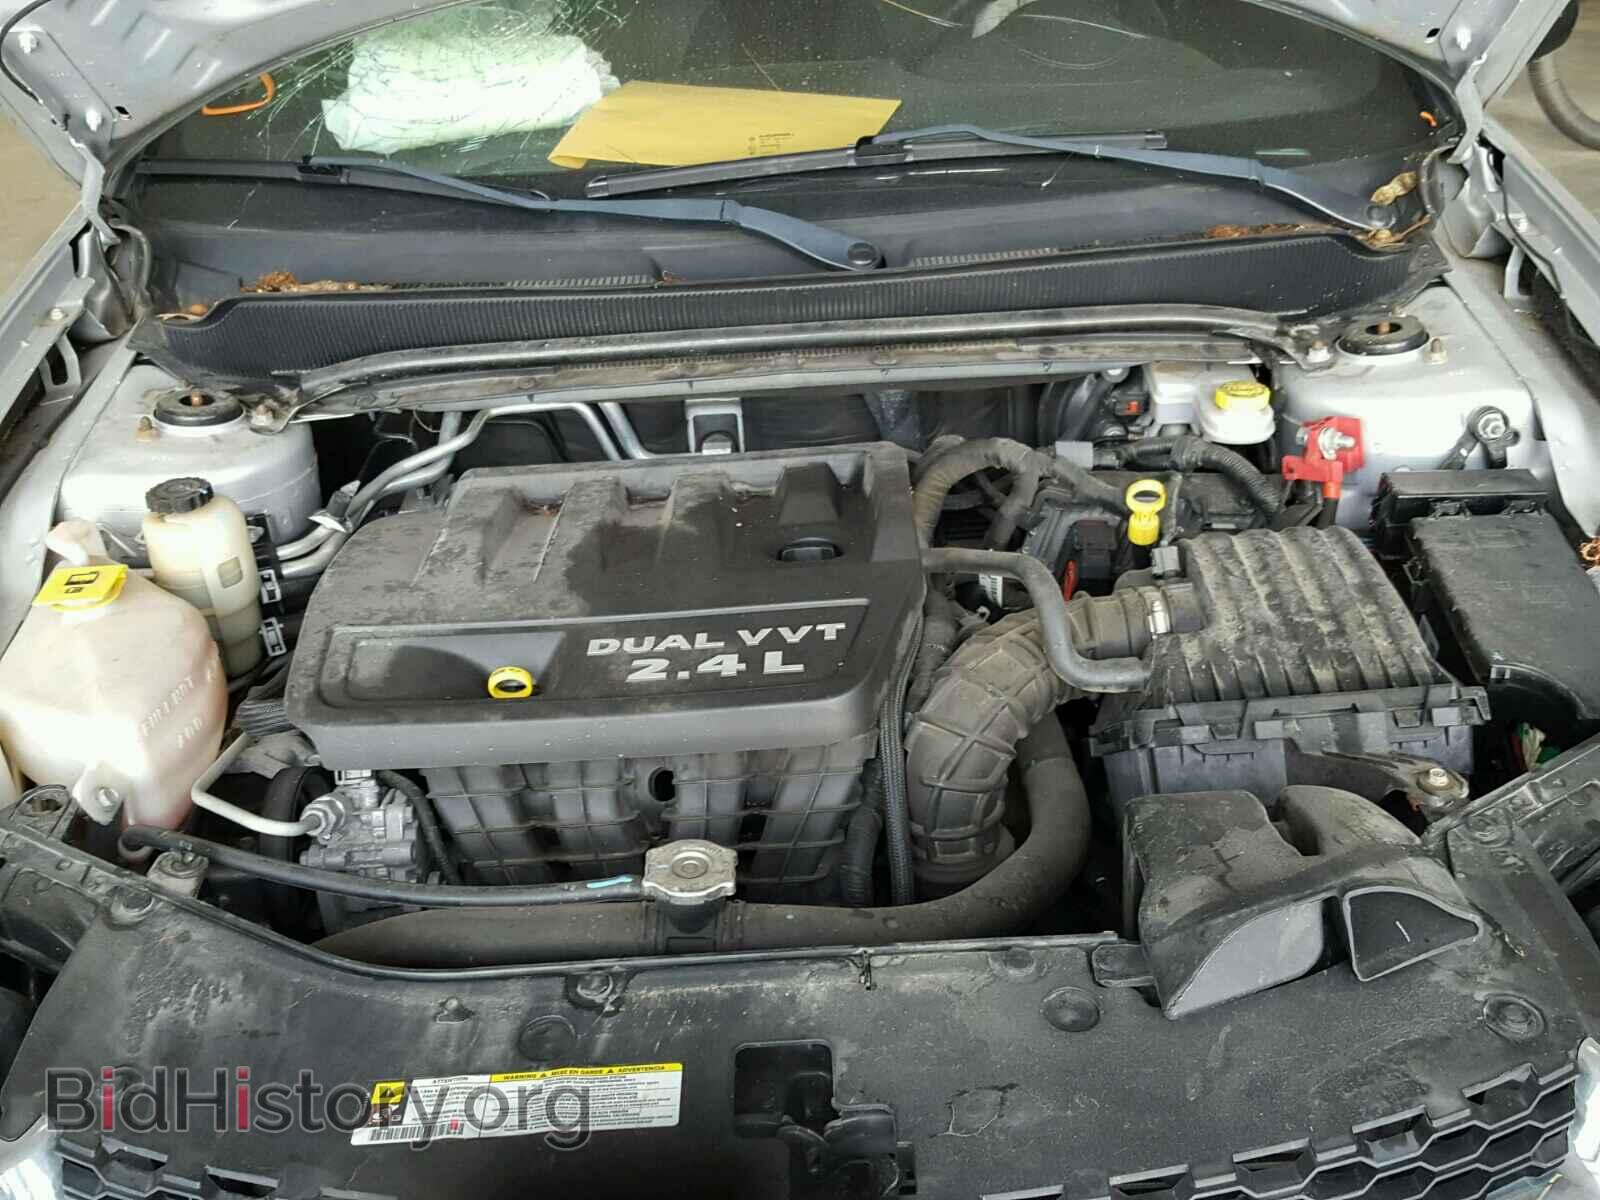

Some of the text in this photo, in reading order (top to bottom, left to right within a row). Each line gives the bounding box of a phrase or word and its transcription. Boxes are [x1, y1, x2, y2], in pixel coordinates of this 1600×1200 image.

[587, 623, 846, 656] DUAL VVT
[503, 1073, 537, 1081] WARNING
